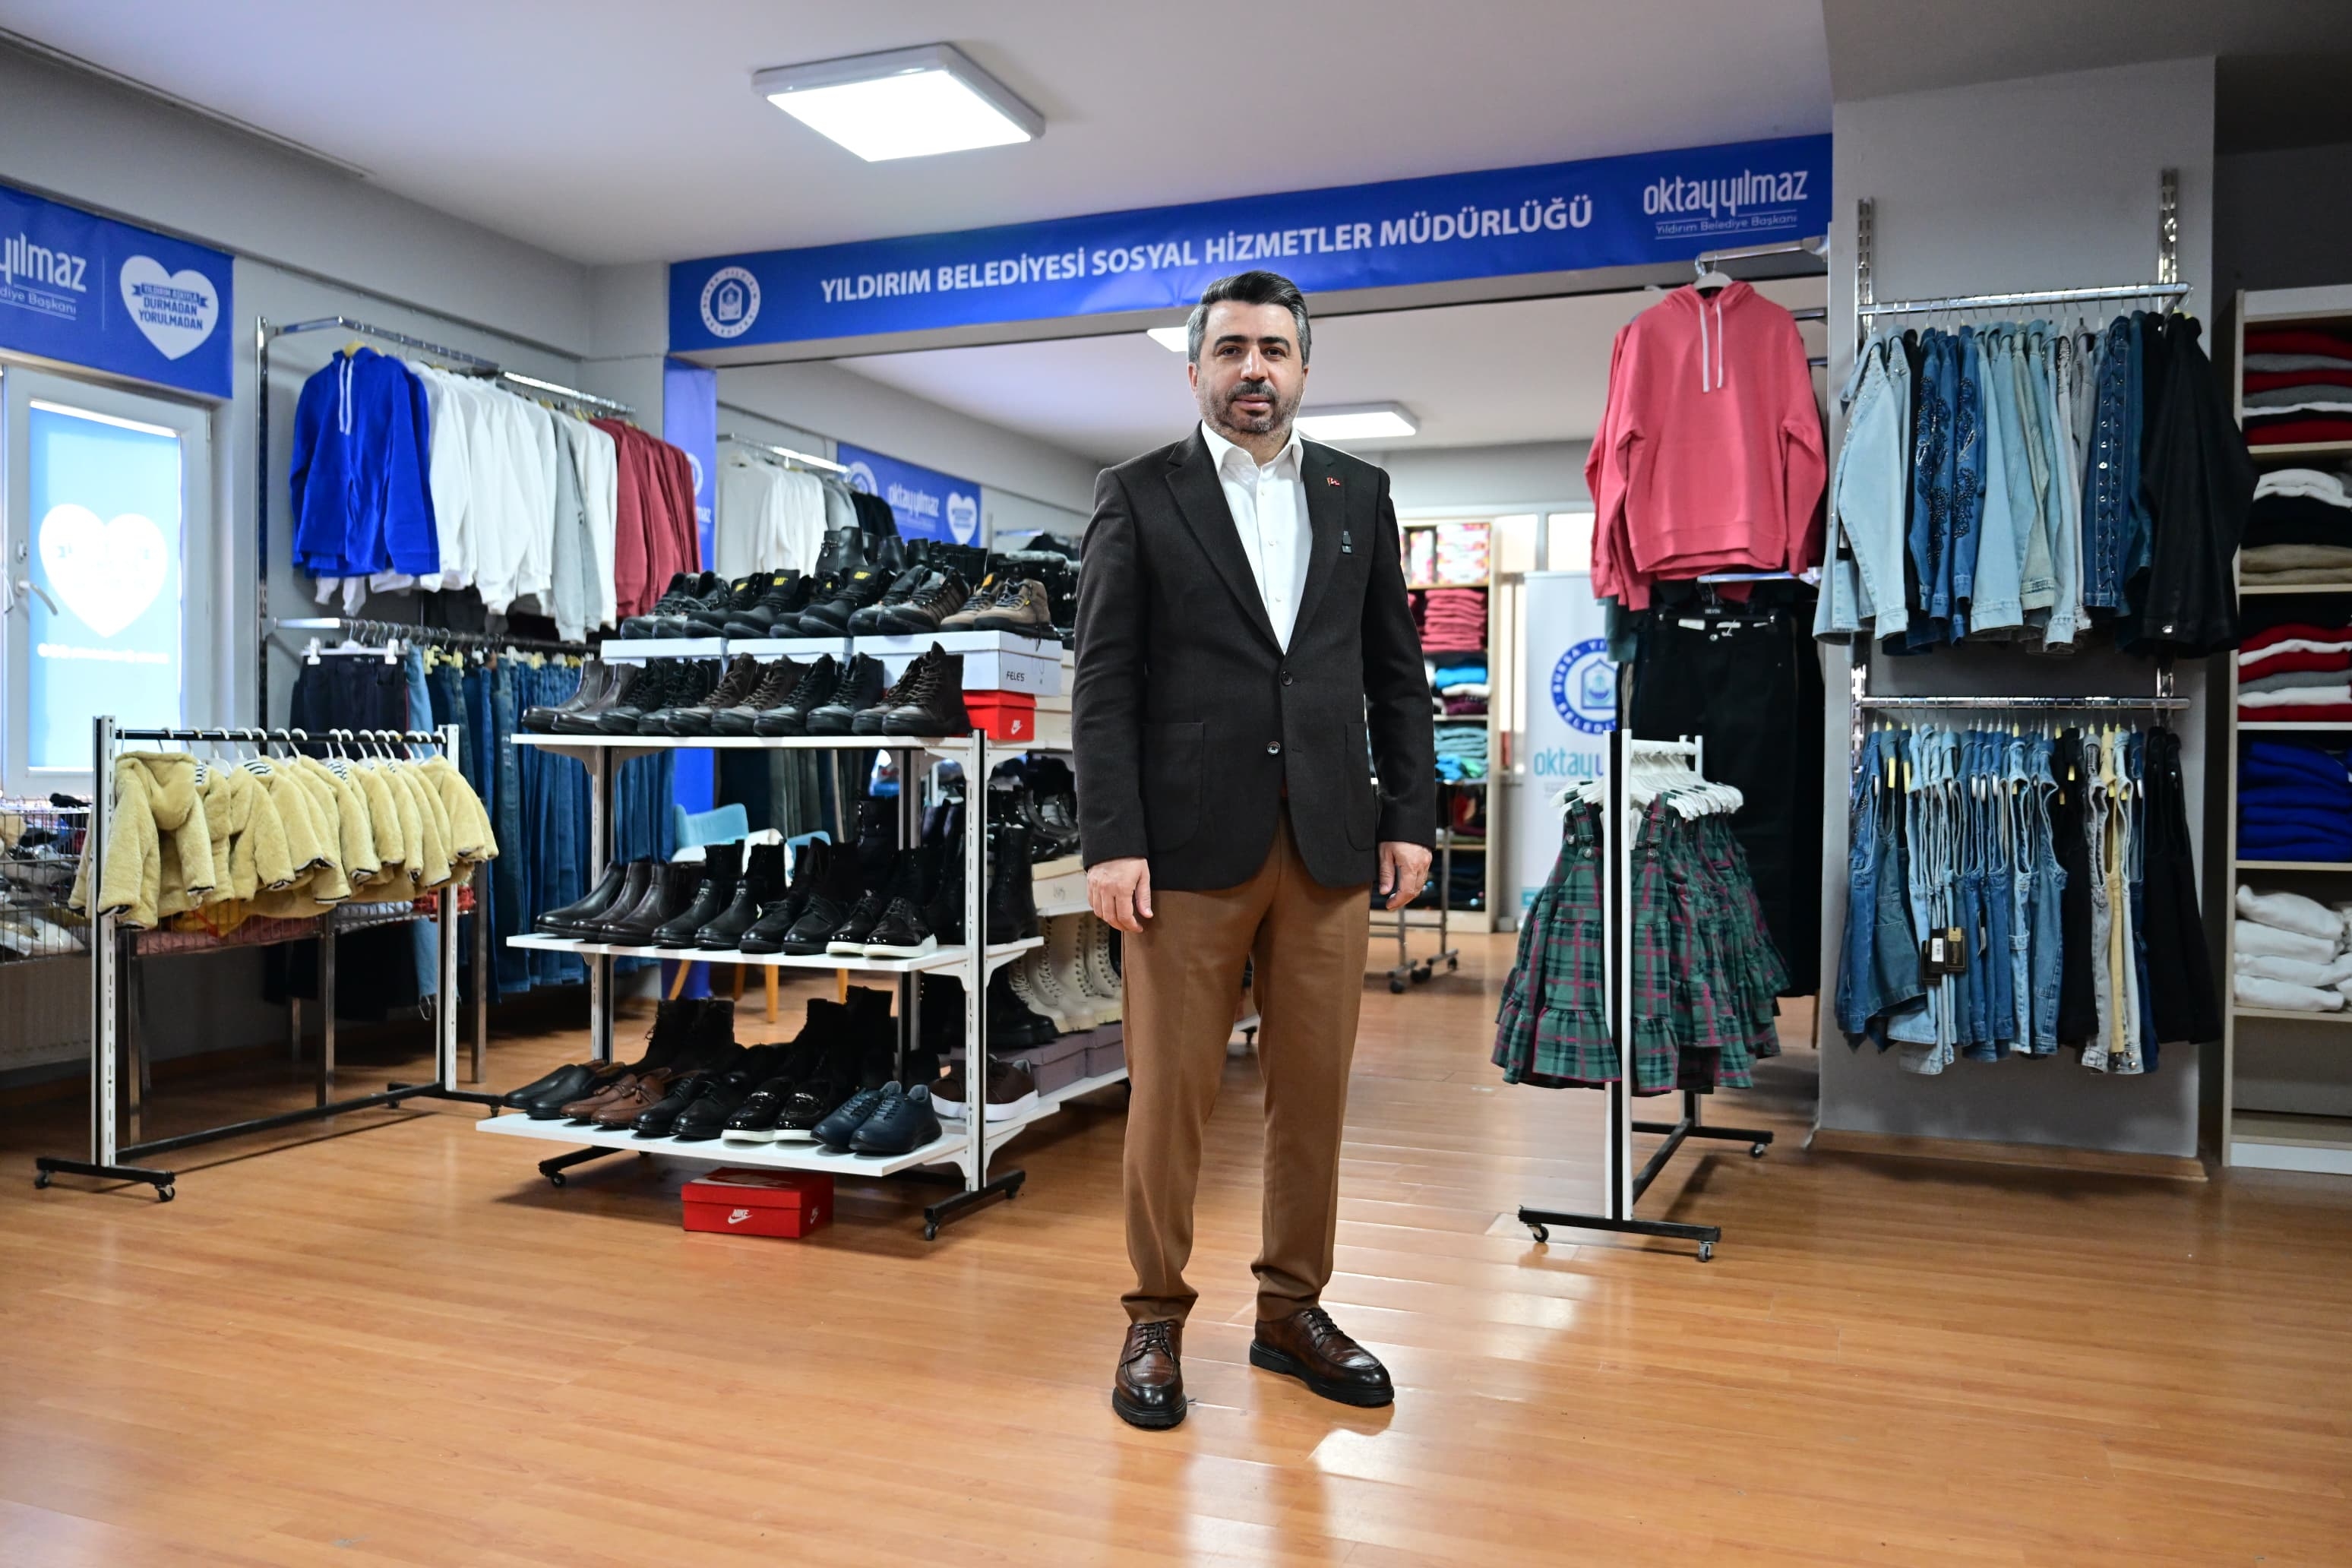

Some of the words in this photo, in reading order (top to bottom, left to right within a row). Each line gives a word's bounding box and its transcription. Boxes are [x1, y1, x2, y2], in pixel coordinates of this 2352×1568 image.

[1643, 175, 1717, 218] oktay
[1720, 169, 1808, 217] yılmaz
[1700, 217, 1749, 231] Belediye
[1751, 213, 1797, 226] Başkanı
[820, 269, 931, 303] YILDIRIM
[937, 247, 1085, 292] BELEDİYESİ
[1092, 240, 1198, 276] SOSYAL
[1205, 223, 1373, 264] HİZMETLER
[1379, 194, 1593, 247] MÜDÜRLÜĞÜ
[29, 292, 77, 315] Başkanı
[144, 297, 198, 315] DURMADAN
[139, 308, 203, 330] YORULMADAN
[1533, 747, 1592, 779] oktay
[732, 1209, 750, 1218] NIKE
